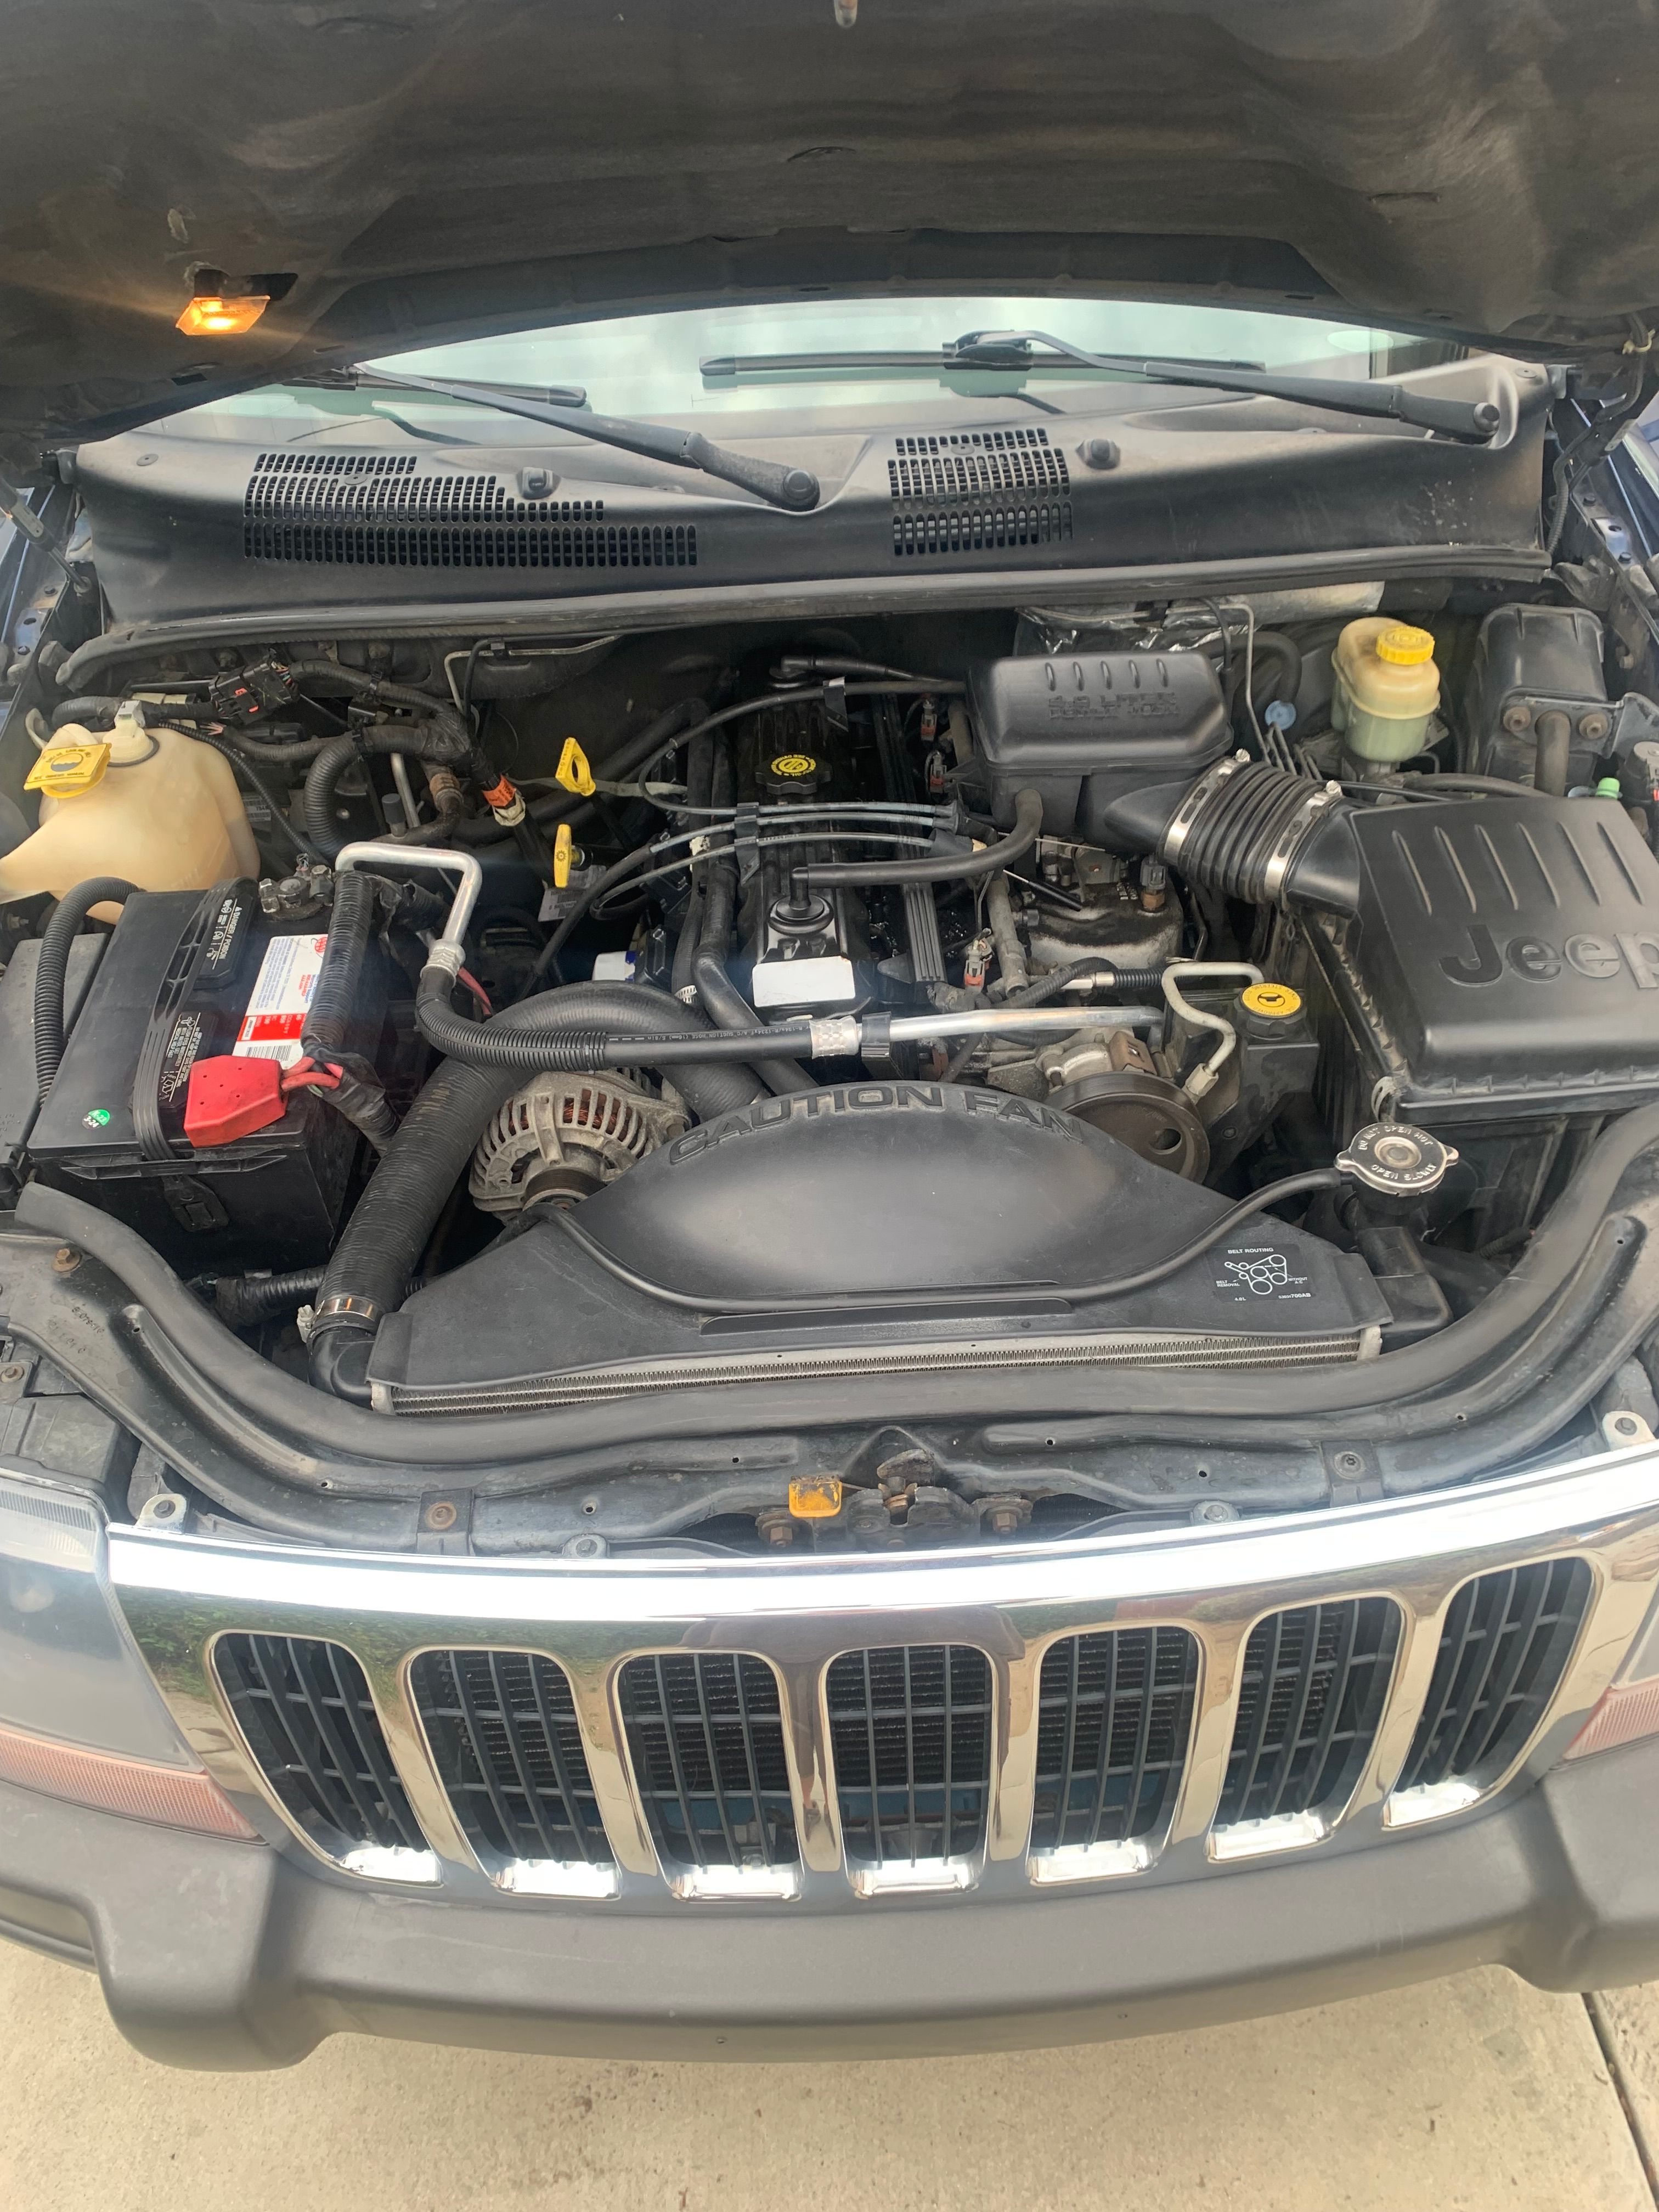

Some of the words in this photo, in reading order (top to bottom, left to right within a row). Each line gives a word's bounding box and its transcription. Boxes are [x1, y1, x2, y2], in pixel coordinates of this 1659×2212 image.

[227, 912, 240, 934] DANGER
[219, 939, 232, 959] POISON
[1438, 924, 1659, 990] Jeep
[83, 1115, 99, 1128] 3-24
[669, 1085, 944, 1166] CAUTION
[963, 1090, 1084, 1145] FAN
[1358, 1140, 1368, 1150] DO
[1364, 1127, 1381, 1140] NOT
[1384, 1125, 1412, 1135] OPEN
[1414, 1132, 1434, 1146] HOT
[1371, 1164, 1399, 1180] OPEN
[1403, 1163, 1437, 1181] SLOWLY
